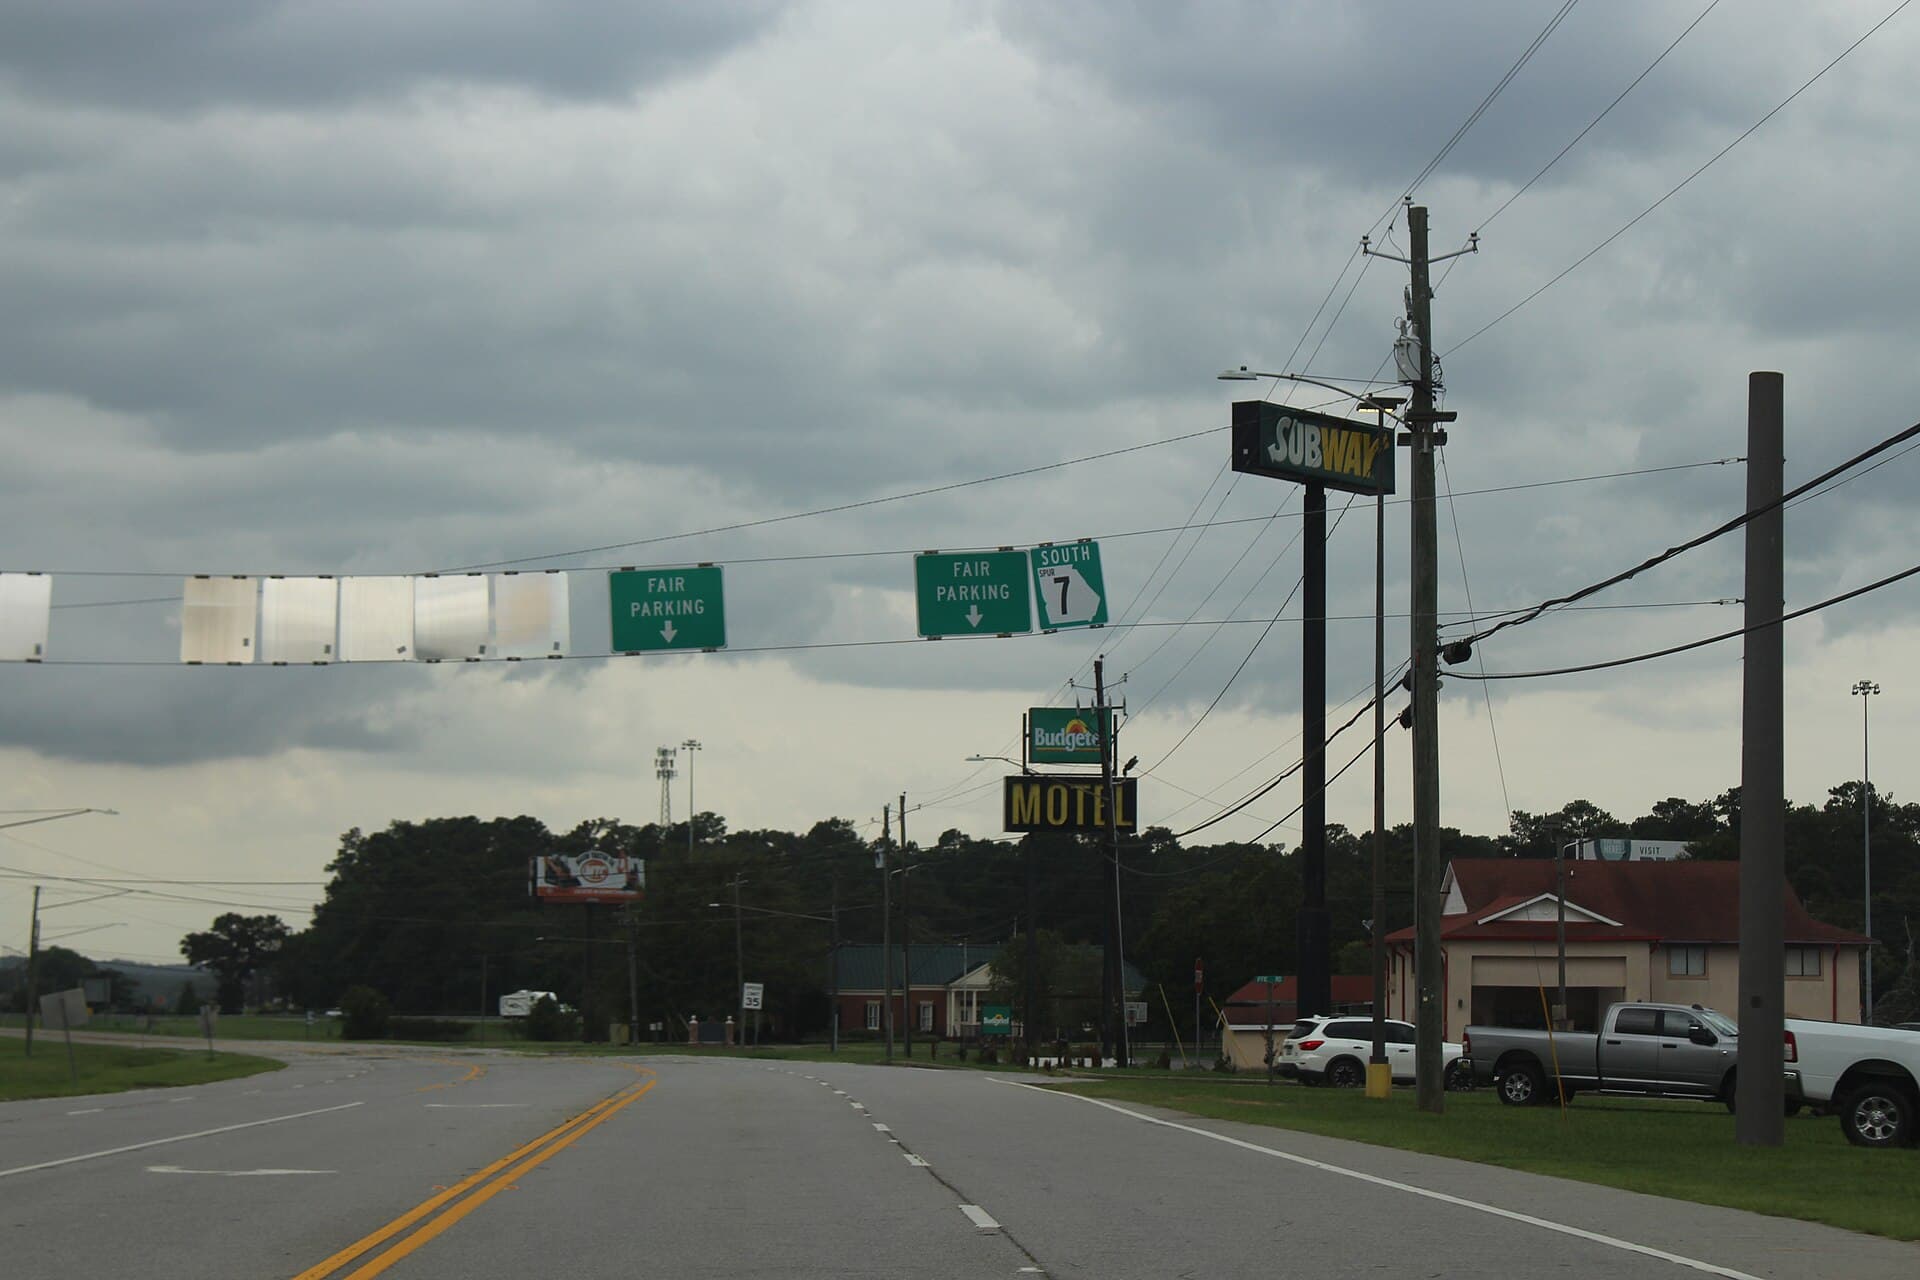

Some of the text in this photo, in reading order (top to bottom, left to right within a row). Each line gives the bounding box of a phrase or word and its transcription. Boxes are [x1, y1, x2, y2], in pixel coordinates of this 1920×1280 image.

[1267, 416, 1380, 478] SUBWAY
[1041, 545, 1091, 566] SOUTH
[953, 561, 991, 577] FAIR
[1039, 568, 1056, 578] SPUR
[647, 577, 685, 593] FAIR
[936, 584, 1010, 601] PARKING
[1053, 575, 1070, 615] 7
[630, 599, 705, 618] PARKING
[1034, 727, 1101, 752] Budgete
[1011, 783, 1133, 827] MOTEL
[1639, 846, 1661, 855] VISIT
[745, 997, 760, 1006] 35
